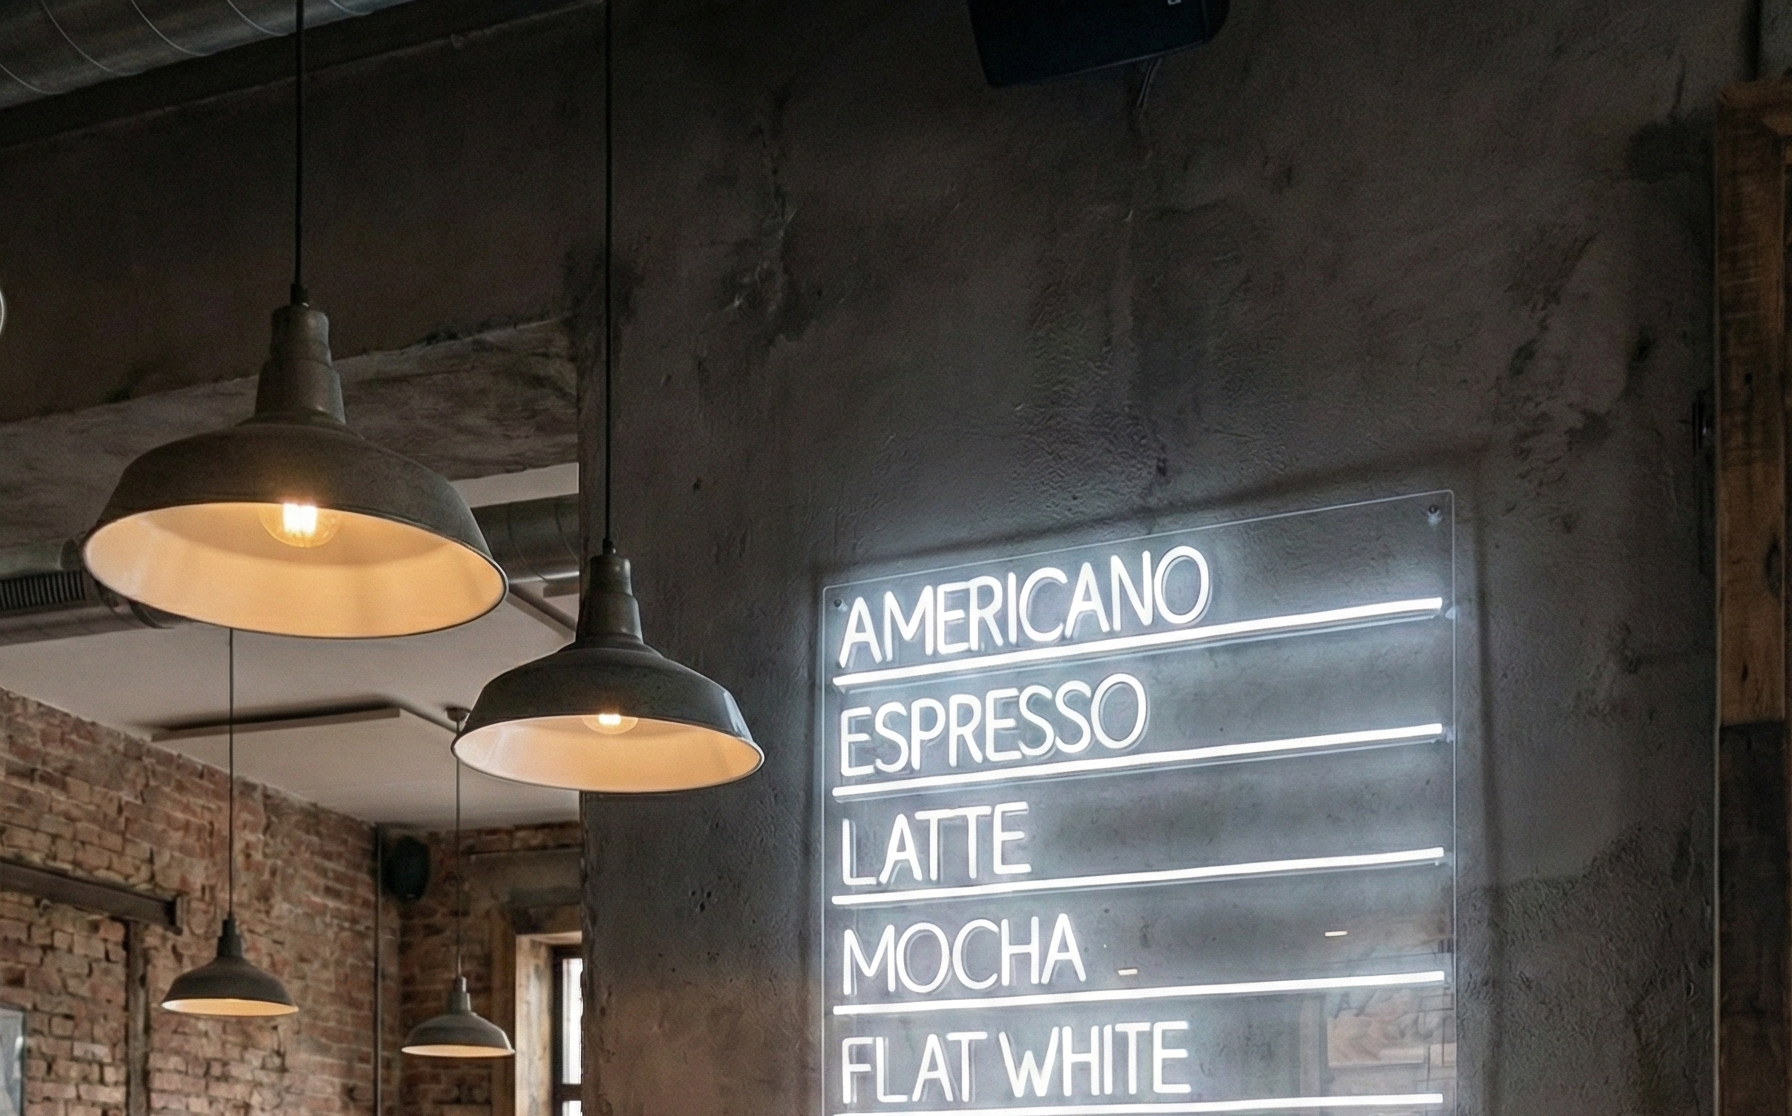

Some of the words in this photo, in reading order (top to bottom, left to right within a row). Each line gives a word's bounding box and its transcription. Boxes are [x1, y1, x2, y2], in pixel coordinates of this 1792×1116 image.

[839, 545, 1210, 668] AMERICANO
[840, 673, 1148, 776] ESPRESSO
[842, 801, 1032, 886] LATTE
[842, 913, 1086, 994] MOCHA
[842, 1031, 987, 1104] FLAT
[998, 1020, 1192, 1098] WHITE
